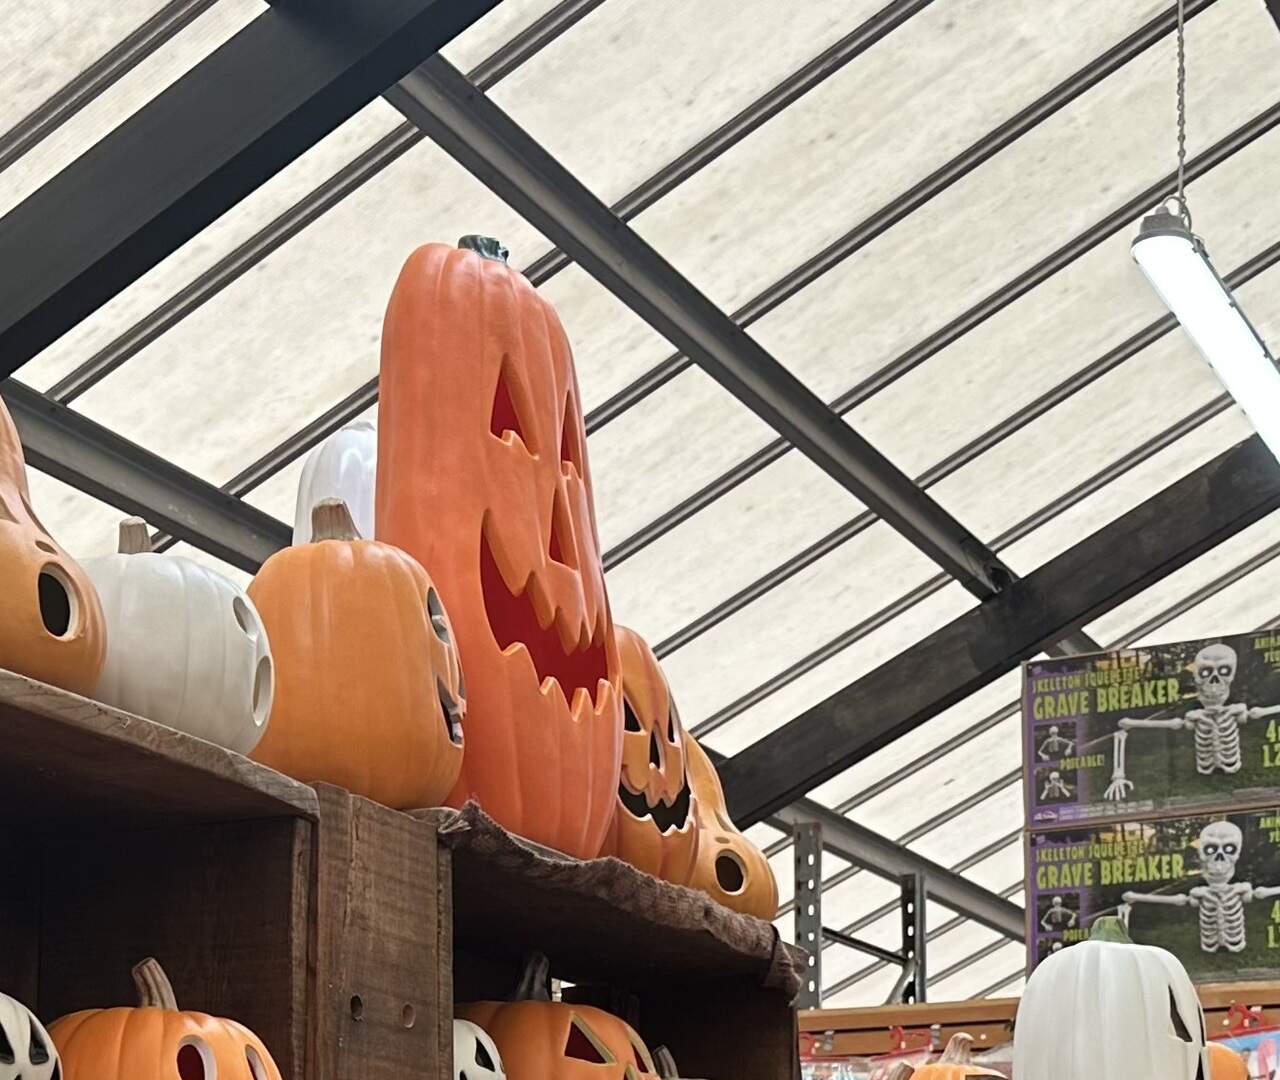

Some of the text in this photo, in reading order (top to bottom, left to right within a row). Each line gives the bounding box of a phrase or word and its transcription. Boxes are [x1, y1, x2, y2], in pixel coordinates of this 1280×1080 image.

[1033, 675, 1081, 693] SKELETON
[1033, 678, 1180, 720] GRAVE BREAKER
[1036, 846, 1084, 862] SKELETON
[1037, 853, 1185, 889] GRAVE BREAKER
